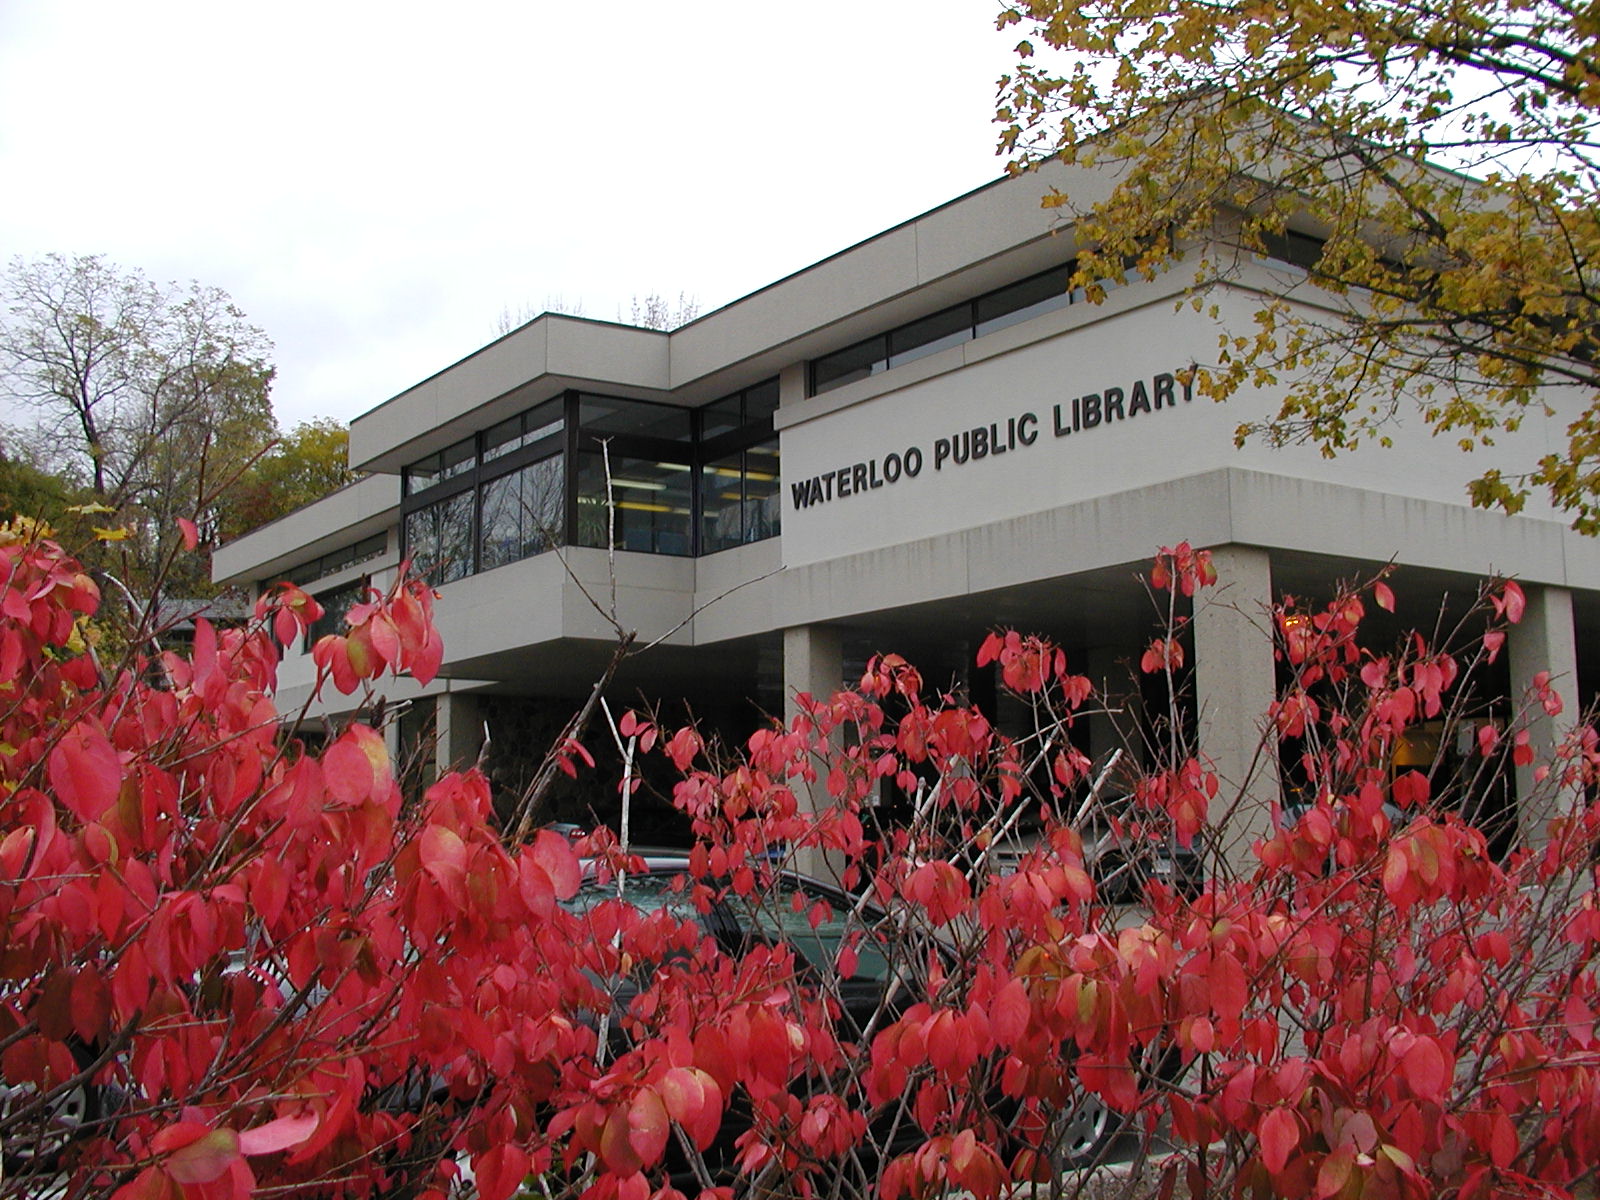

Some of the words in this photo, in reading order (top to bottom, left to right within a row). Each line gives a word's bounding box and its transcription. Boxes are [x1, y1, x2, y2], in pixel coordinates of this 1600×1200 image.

[791, 447, 922, 509] WATERLOO
[934, 412, 1039, 470] PUBLIC
[1053, 363, 1198, 437] LIBRARY
